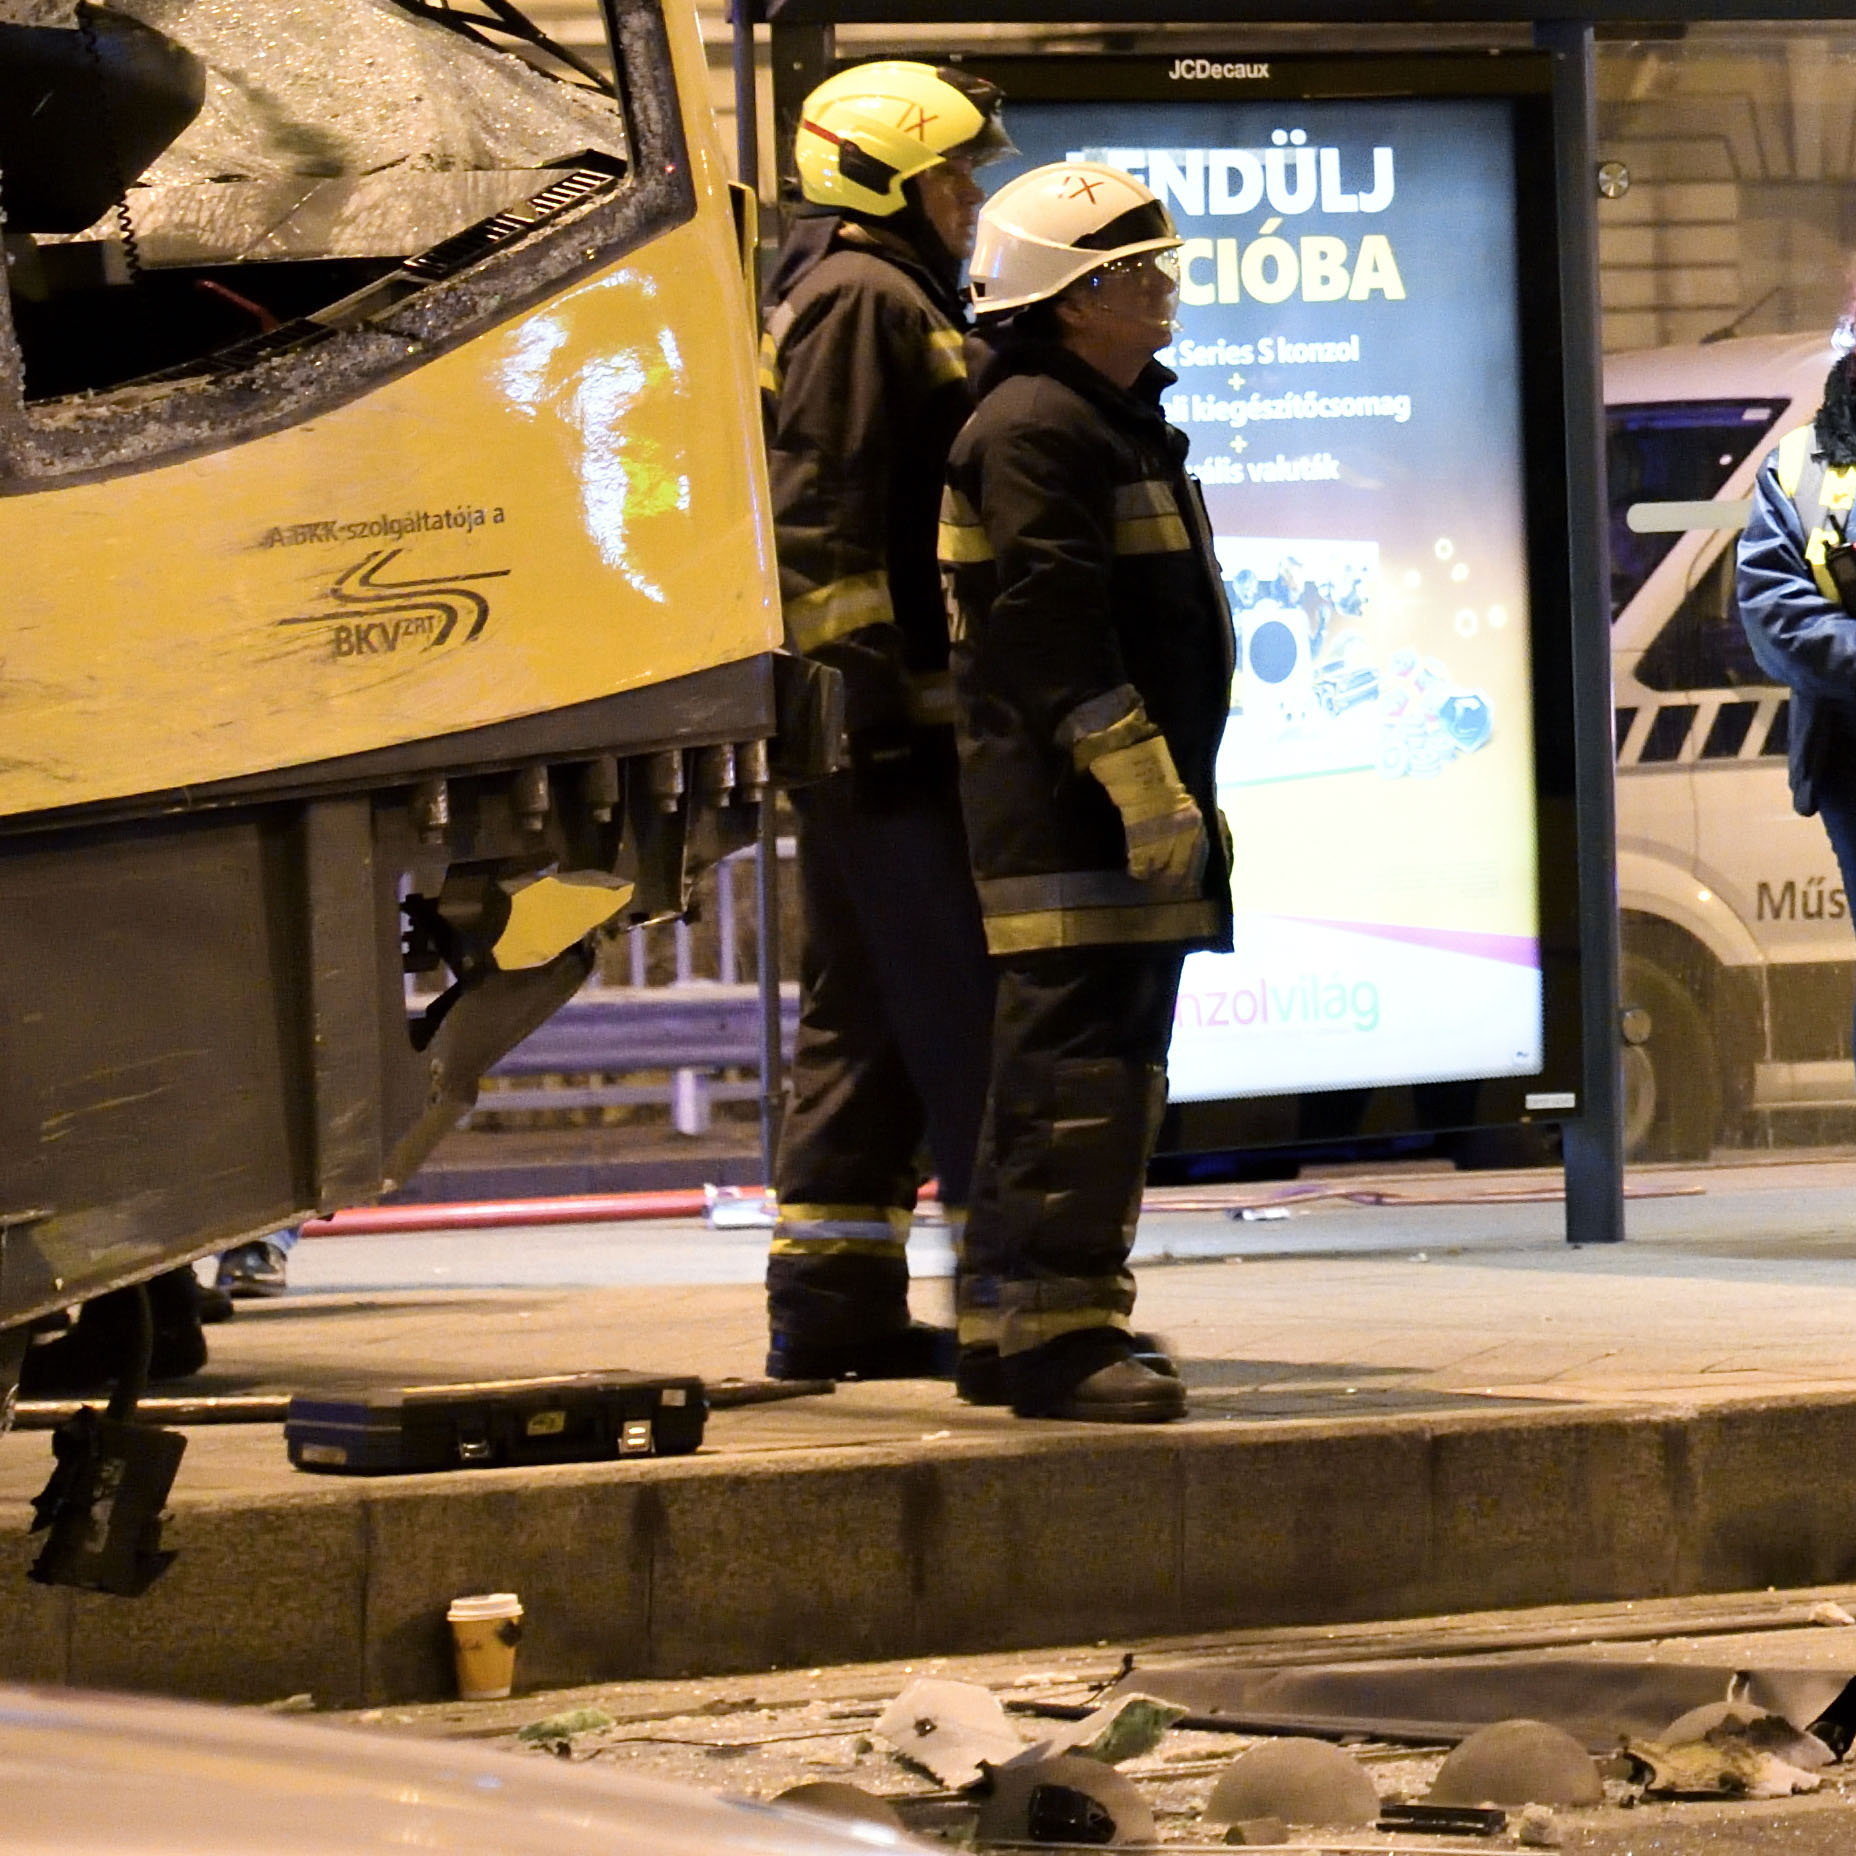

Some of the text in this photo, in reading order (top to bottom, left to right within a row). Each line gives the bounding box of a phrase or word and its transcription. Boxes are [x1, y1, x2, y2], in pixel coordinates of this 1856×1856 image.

[1168, 58, 1270, 79] JCDecaux
[1065, 128, 1396, 216] NDÜLJ
[1179, 339, 1254, 367] Series
[1257, 337, 1275, 365] S
[1277, 335, 1360, 364] konzol
[1191, 392, 1412, 428] kiegészítőcsomag
[1247, 453, 1341, 483] valuták
[492, 506, 505, 523] a
[335, 621, 402, 657] BKV
